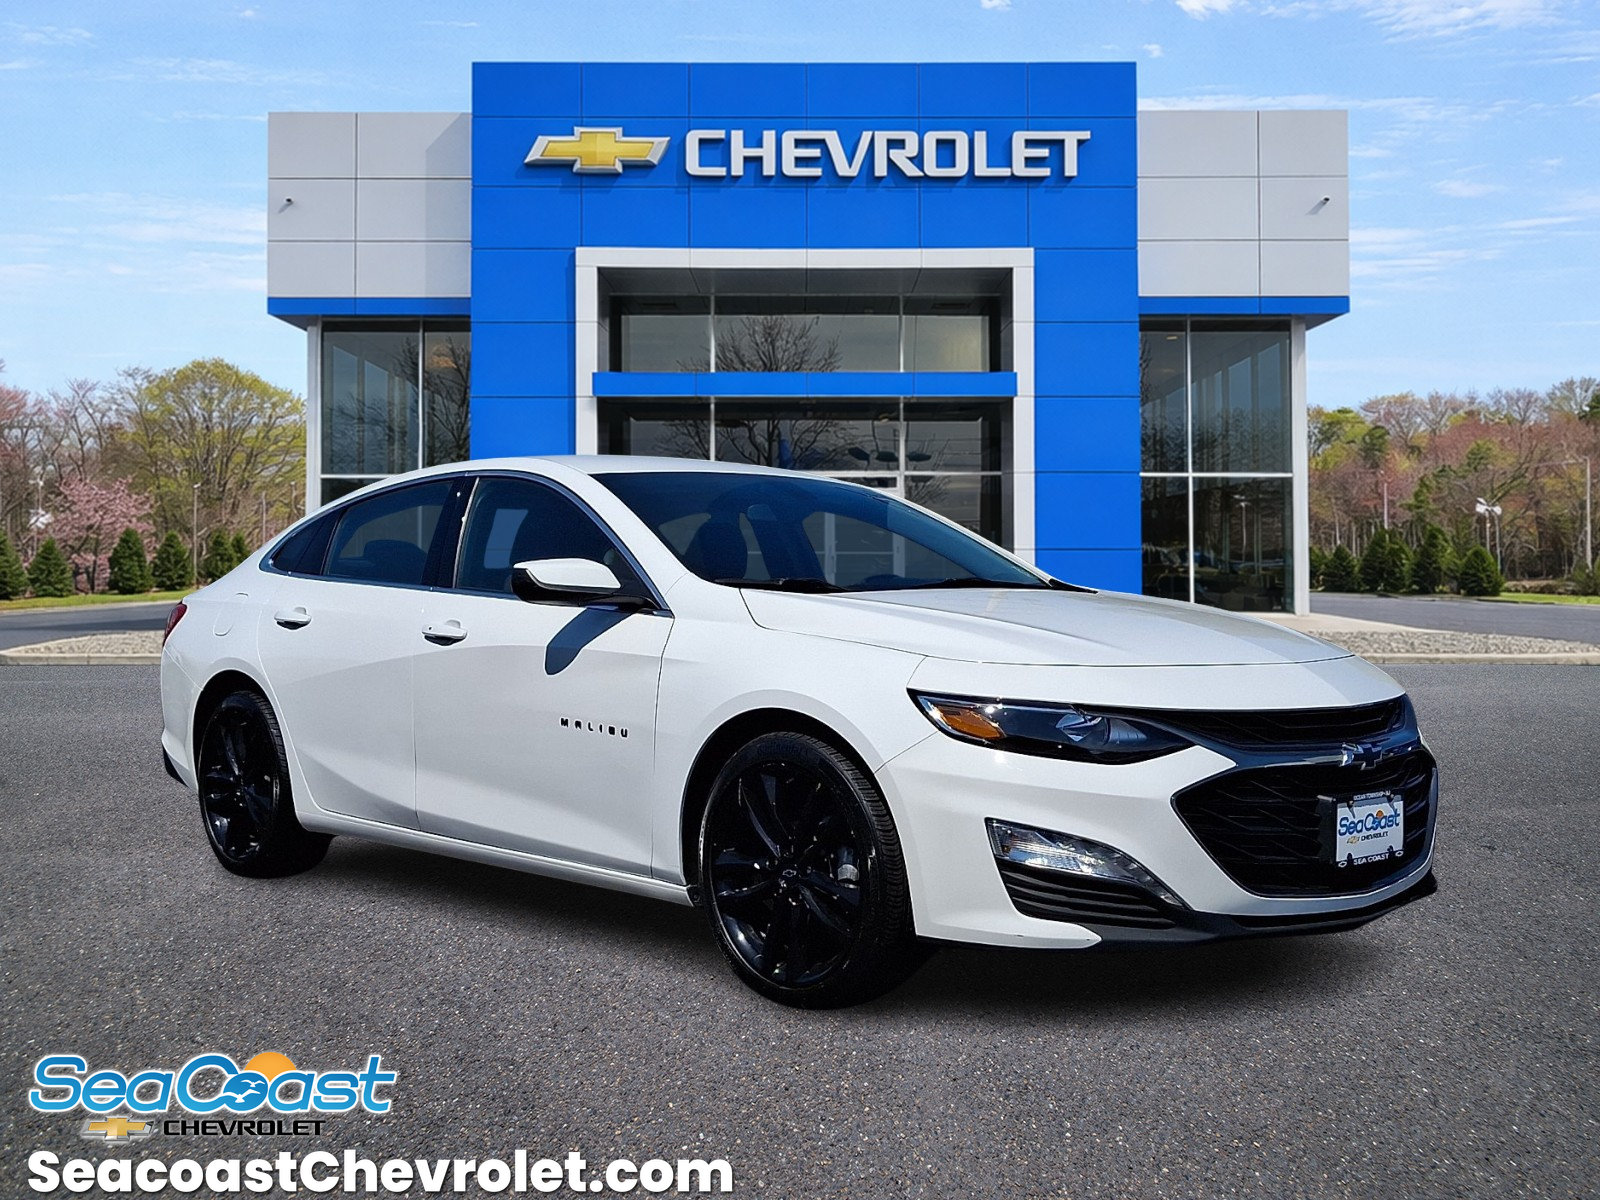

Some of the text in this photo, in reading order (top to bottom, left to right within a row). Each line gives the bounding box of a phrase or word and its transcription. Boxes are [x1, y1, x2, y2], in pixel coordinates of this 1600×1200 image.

[685, 130, 1091, 177] CHEVROLET
[560, 717, 628, 738] MALIBU
[1361, 831, 1389, 841] CHEVROLET
[1353, 853, 1389, 865] SEA COAST
